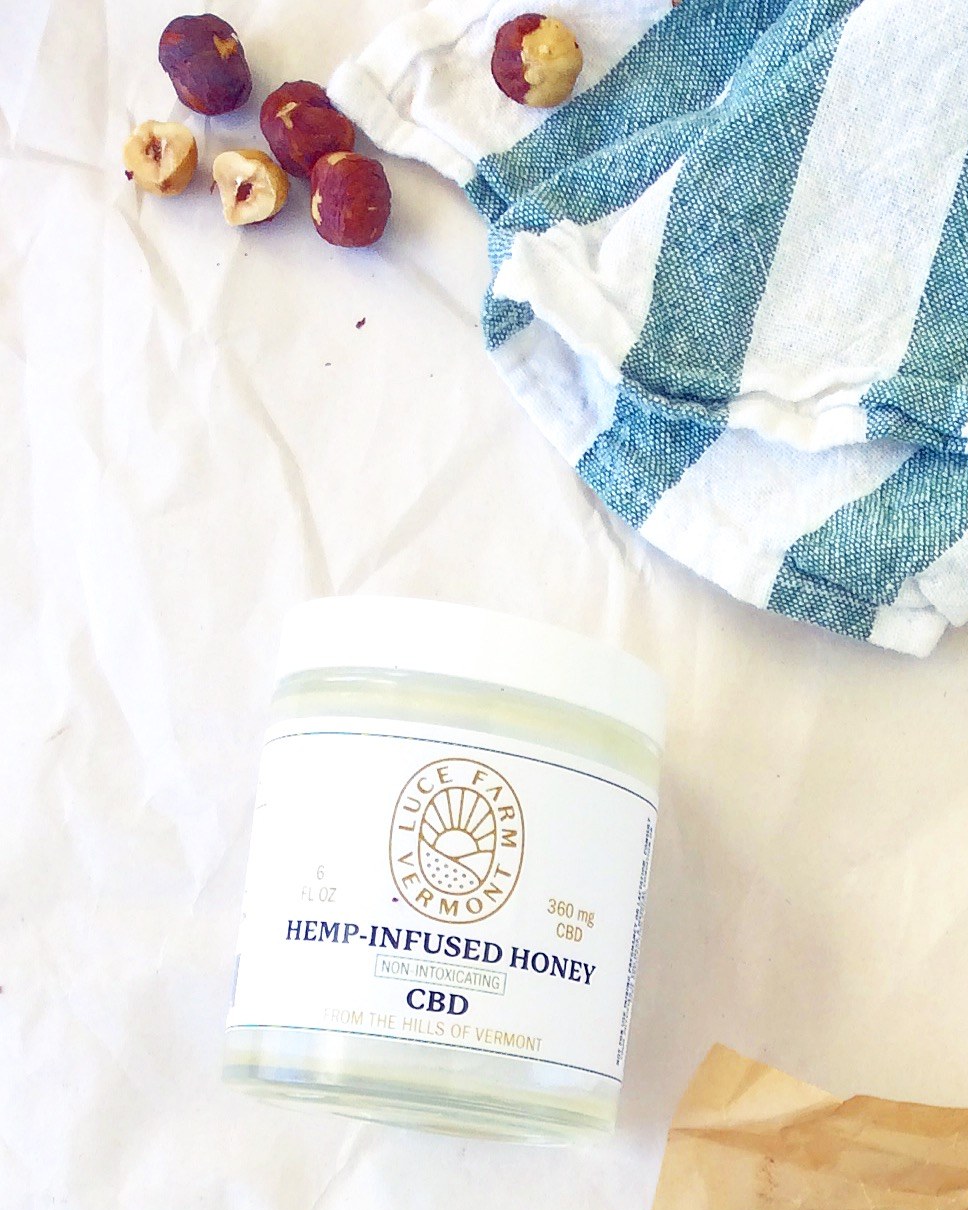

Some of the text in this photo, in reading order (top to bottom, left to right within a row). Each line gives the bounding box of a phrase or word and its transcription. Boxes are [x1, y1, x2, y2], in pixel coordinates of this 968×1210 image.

[399, 766, 518, 848] LUCE FARM
[316, 864, 325, 880] 6
[397, 851, 512, 917] VERMONT
[301, 885, 337, 902] FL OZ
[546, 899, 595, 929] 360 mg
[556, 922, 583, 943] CBD
[285, 919, 597, 985] HEMP-INFUSED HONEY
[381, 959, 501, 990] NON-INTOXICATING
[406, 988, 469, 1015] CBD
[324, 1007, 543, 1052] FROM THE HILLS OF VERMONT
